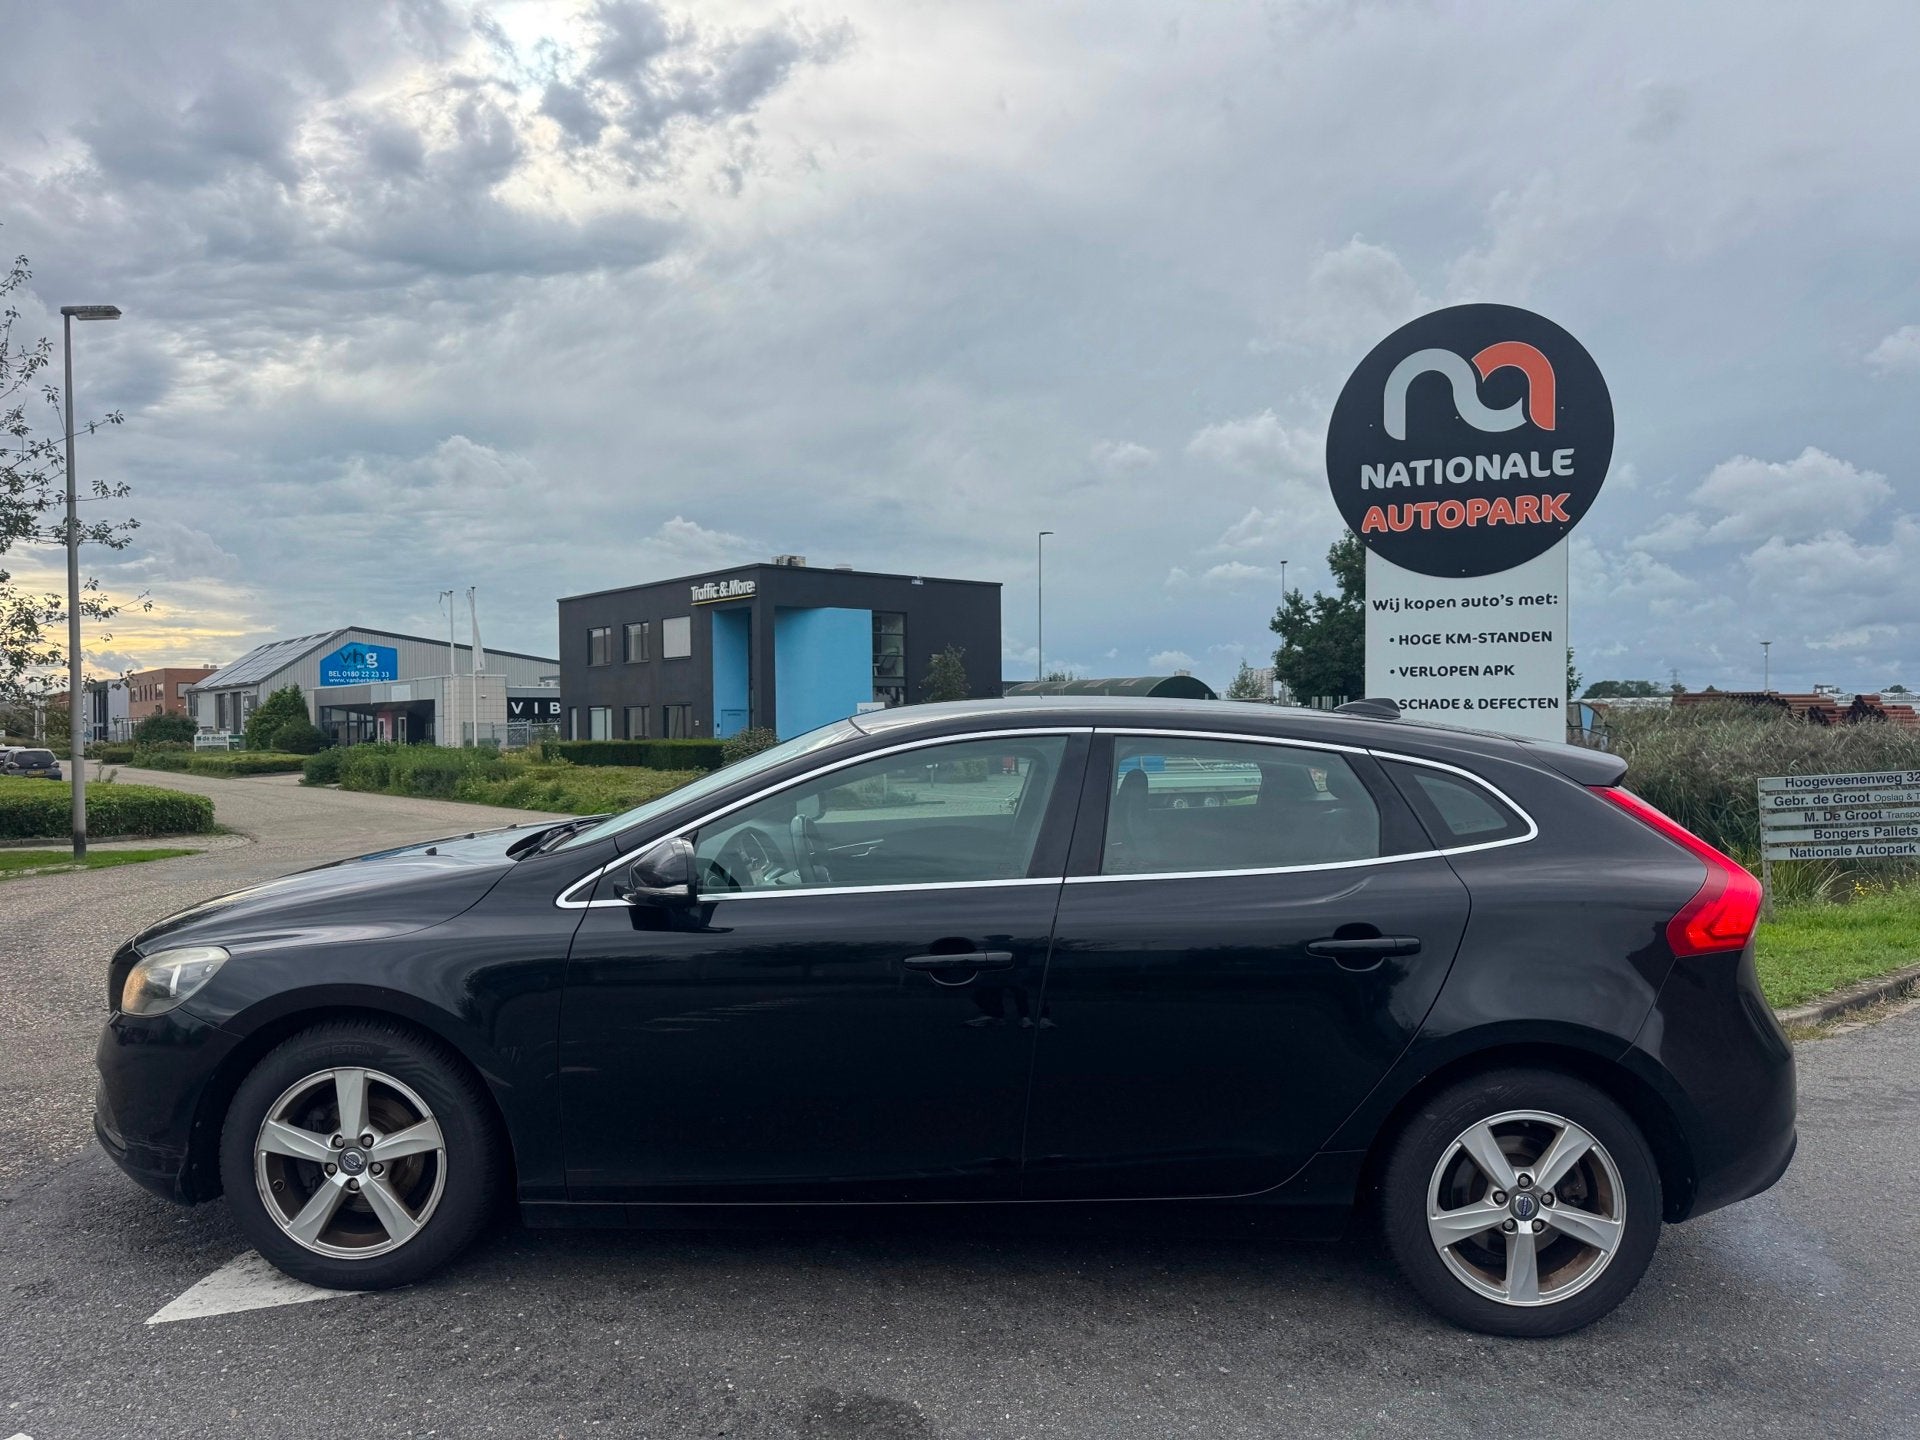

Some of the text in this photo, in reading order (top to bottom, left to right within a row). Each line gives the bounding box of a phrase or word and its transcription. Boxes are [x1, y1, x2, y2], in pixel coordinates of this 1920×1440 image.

[1360, 448, 1575, 490] NATIONALE
[1361, 492, 1571, 533] AUTOPARK
[691, 580, 756, 600] Traffic & More
[1372, 593, 1558, 613] Wij kopen auto's met:
[1398, 631, 1553, 645] HOGE KM-STANDEN
[340, 648, 378, 668] vhg
[1398, 665, 1515, 677] VERLOPEN APK
[1399, 698, 1559, 710] SCHADE & DEFECTEN
[1785, 772, 1920, 789] Hoogeveenenweg 32
[1774, 795, 1809, 806] Gebr.
[1812, 794, 1829, 805] de
[1832, 792, 1870, 804] Groot
[1874, 793, 1904, 803] Opslag
[1804, 812, 1819, 822] M.
[1823, 811, 1841, 821] De
[1845, 810, 1883, 820] Groot
[1813, 826, 1919, 840] Bongers Pallets
[1789, 843, 1917, 858] Nationale Autopark
